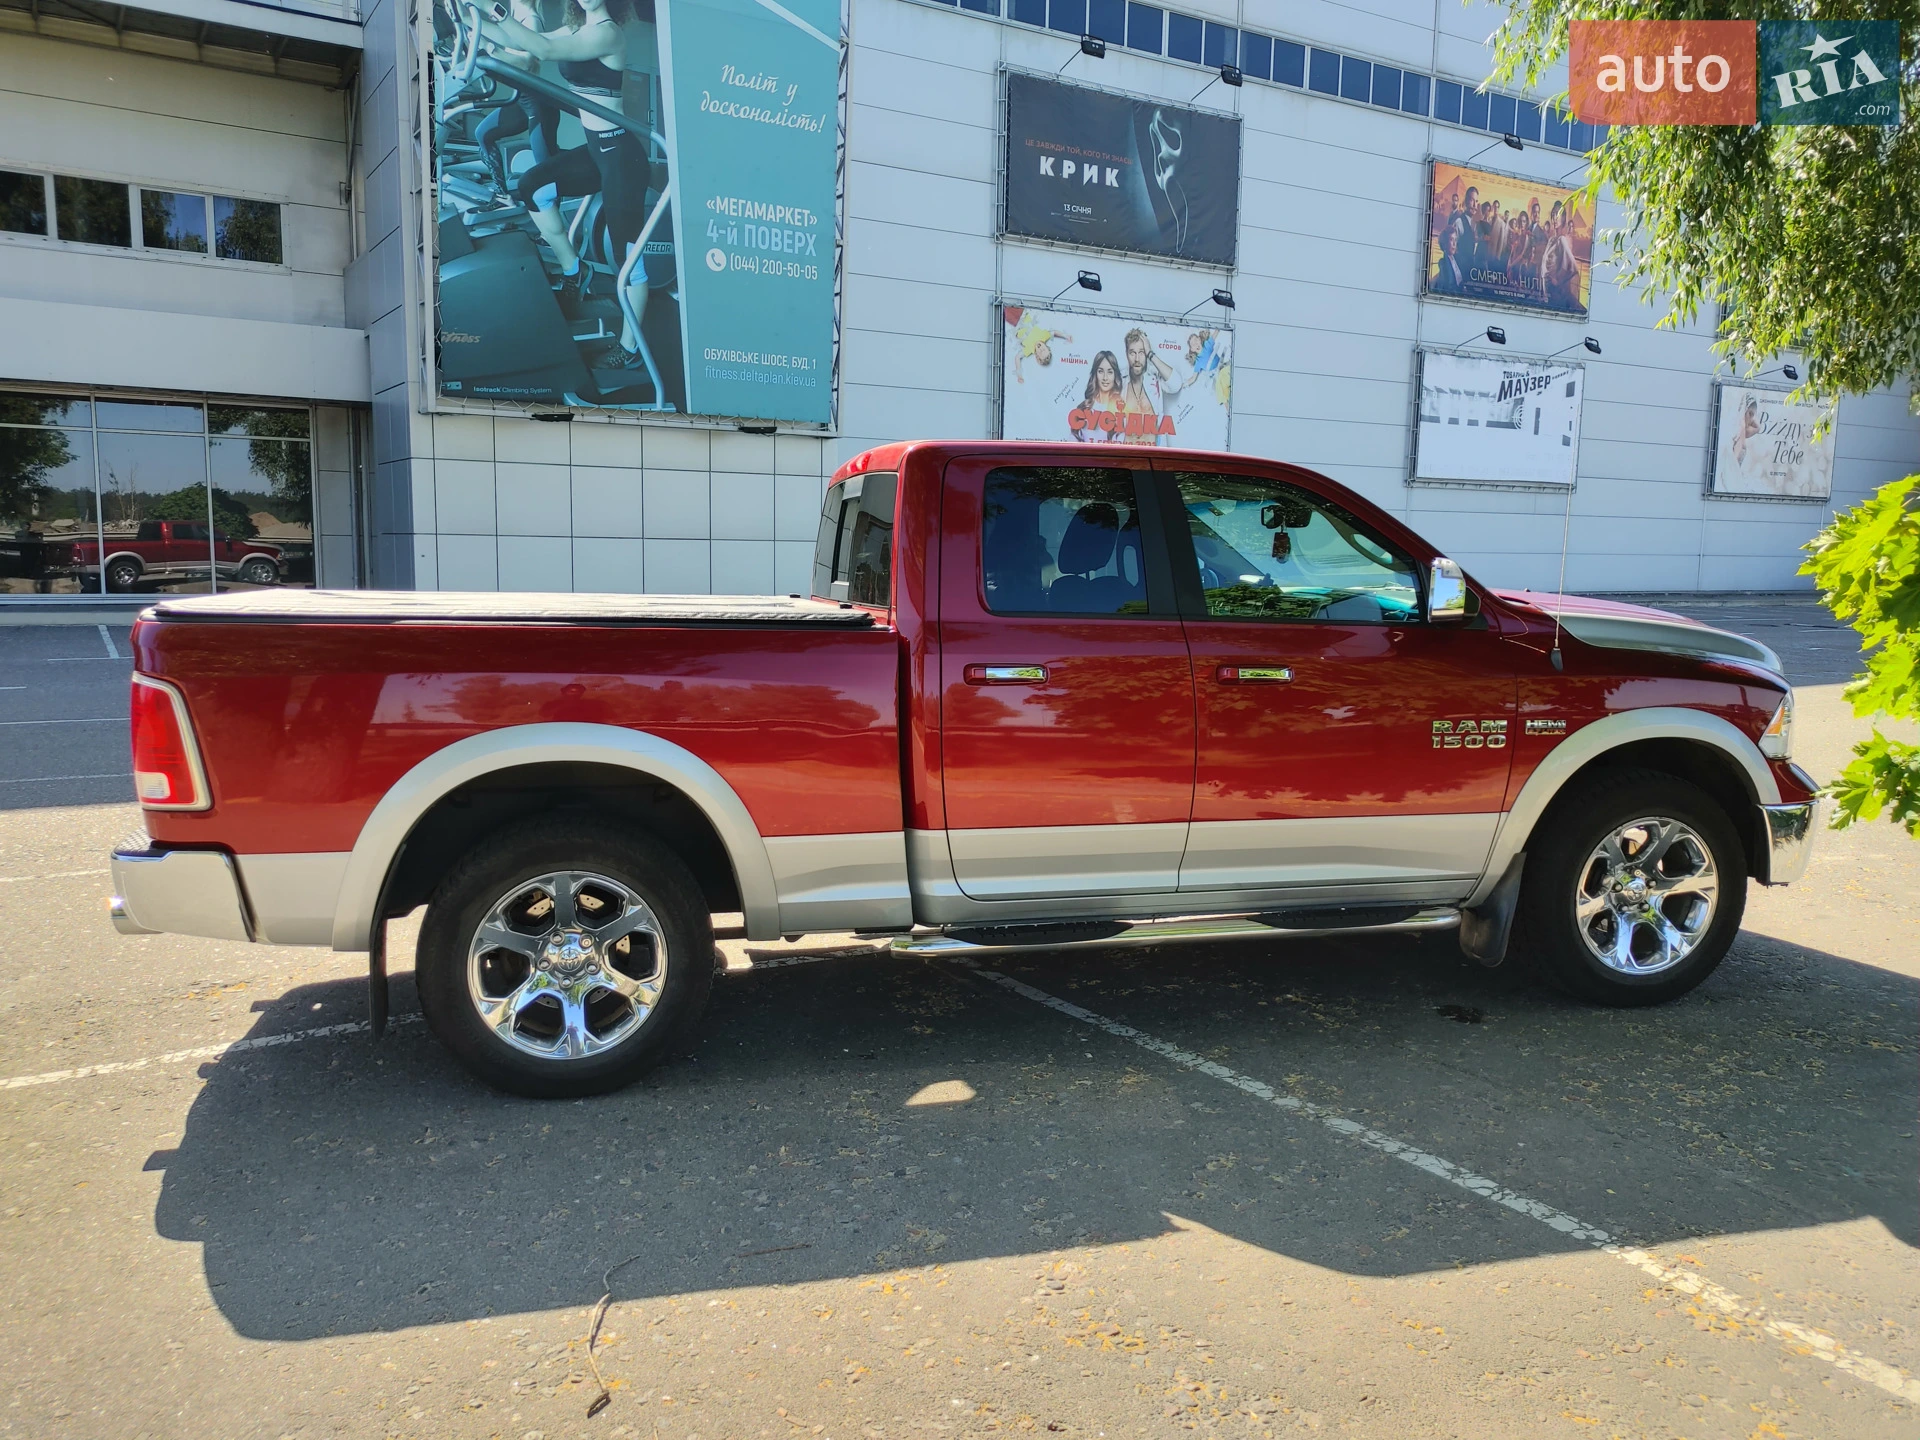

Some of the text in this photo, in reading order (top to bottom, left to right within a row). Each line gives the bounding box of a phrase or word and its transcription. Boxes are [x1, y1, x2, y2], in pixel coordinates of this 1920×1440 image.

[721, 64, 798, 106] Політ у
[700, 90, 826, 133] досконалість!
[1040, 155, 1120, 188] КРИК
[706, 195, 818, 227] «МЕГАМАРКЕТ»
[1063, 203, 1071, 212] 13
[1071, 205, 1092, 215] СІЧНЯ
[645, 243, 672, 253] RECOR
[744, 223, 817, 257] ПОВЕРХ
[730, 252, 818, 280] (044) 200-50-05
[1469, 267, 1508, 286] СМЕРТЬ
[704, 348, 817, 370] ОБУХІВСЬКЕ ШОСЕ, БУД. 1
[1060, 357, 1089, 365] МІШИНА
[705, 365, 816, 387] fitness.deltaplan.kiev.ua
[501, 387, 529, 395] Climbing
[1068, 408, 1176, 436] СУСІДКА
[1432, 720, 1507, 733] RAM
[1526, 720, 1566, 728] HEMI
[1432, 735, 1507, 749] 1500
